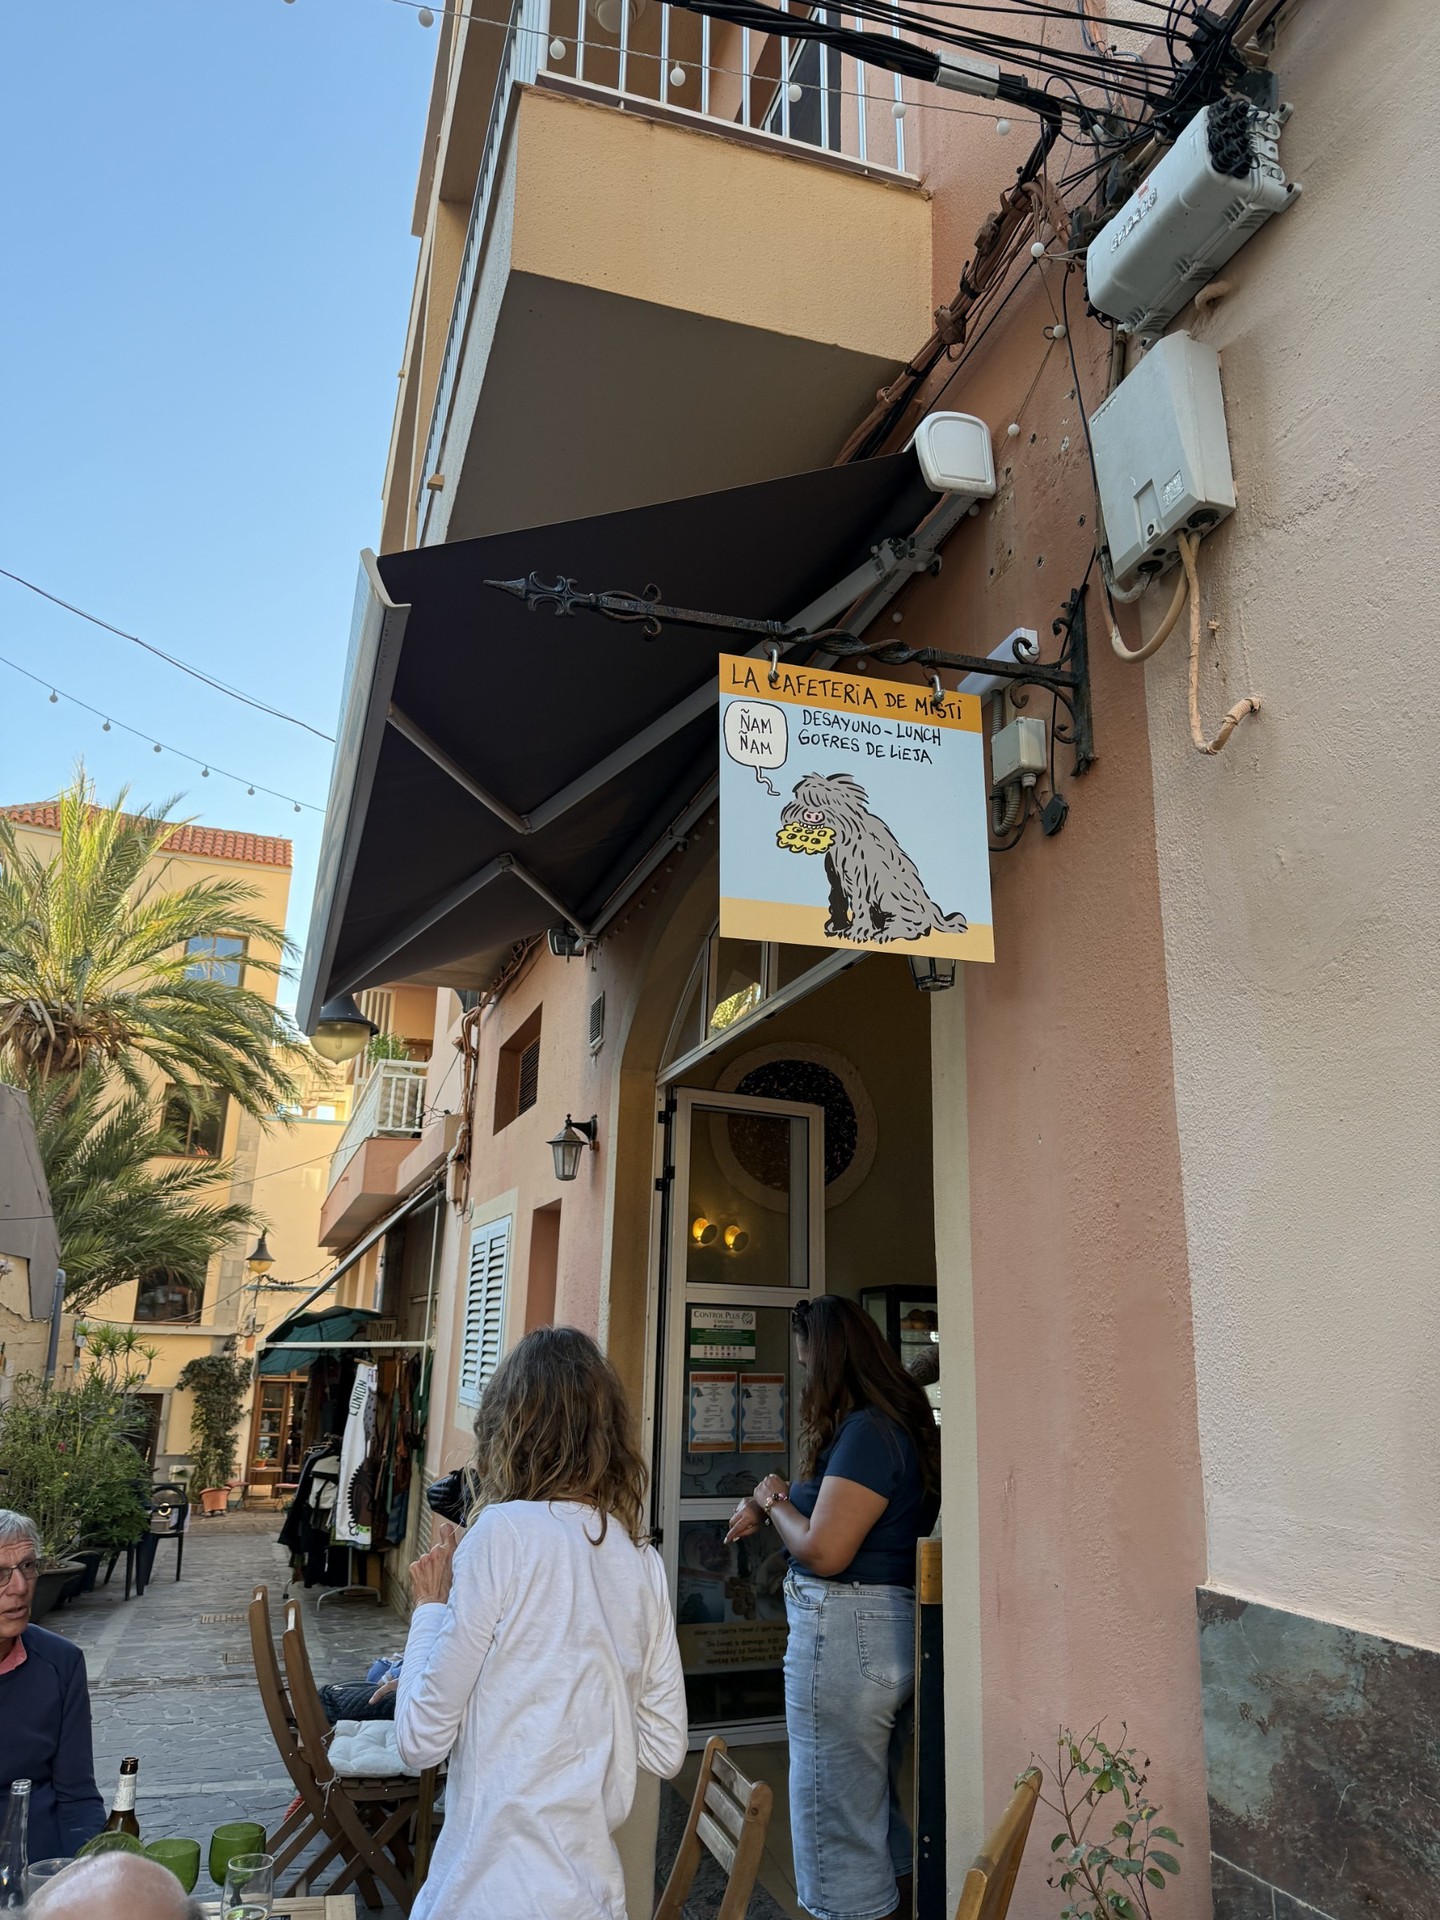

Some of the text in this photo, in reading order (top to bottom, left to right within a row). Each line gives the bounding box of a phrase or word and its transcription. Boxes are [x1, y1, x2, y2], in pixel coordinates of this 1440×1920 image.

[732, 663, 760, 693] LA
[884, 692, 908, 709] DE
[740, 708, 773, 734] ÑAM
[739, 729, 773, 755] ÑAM
[798, 729, 860, 752] GOFRES
[866, 742, 886, 758] DE
[896, 723, 941, 746] LUNCH
